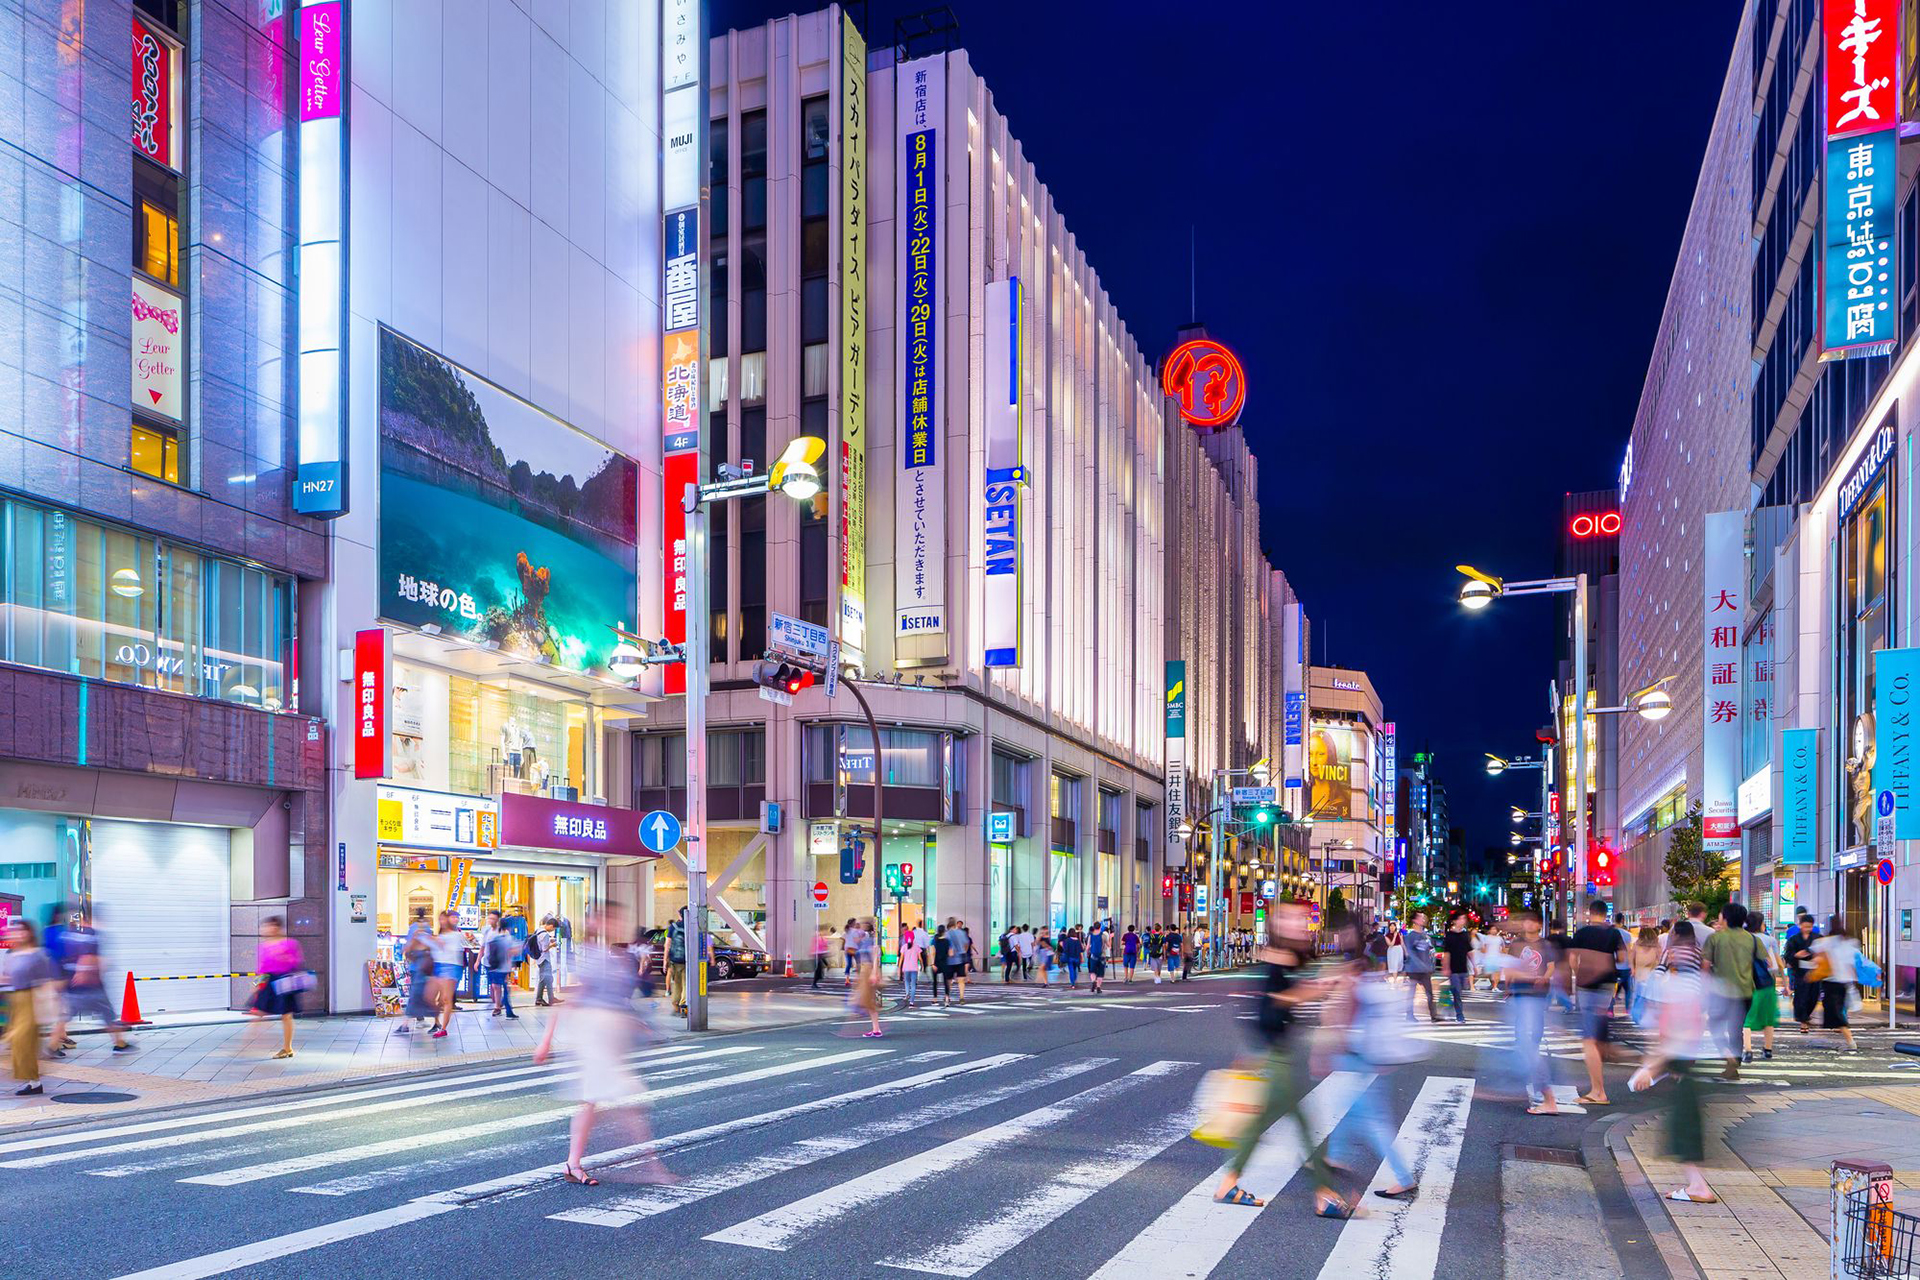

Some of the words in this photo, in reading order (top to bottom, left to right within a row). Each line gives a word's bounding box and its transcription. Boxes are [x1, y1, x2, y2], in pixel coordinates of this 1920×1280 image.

[313, 13, 331, 54] Leur
[670, 133, 693, 149] MUJI
[139, 337, 171, 356] Leur
[134, 356, 175, 378] Getter
[667, 365, 691, 422] 北海道
[674, 436, 689, 448] 4F
[302, 477, 335, 494] HN27
[398, 573, 483, 622] 地球の色。
[774, 617, 827, 645] 新宿三丁目西
[1710, 589, 1738, 724] 大和証券
[362, 671, 375, 738] 無印良品
[1318, 765, 1348, 781] VINCI
[1168, 760, 1182, 844] 三井住友銀行
[554, 814, 607, 840] 無印良品
[1792, 787, 1808, 848] TIFFANY
